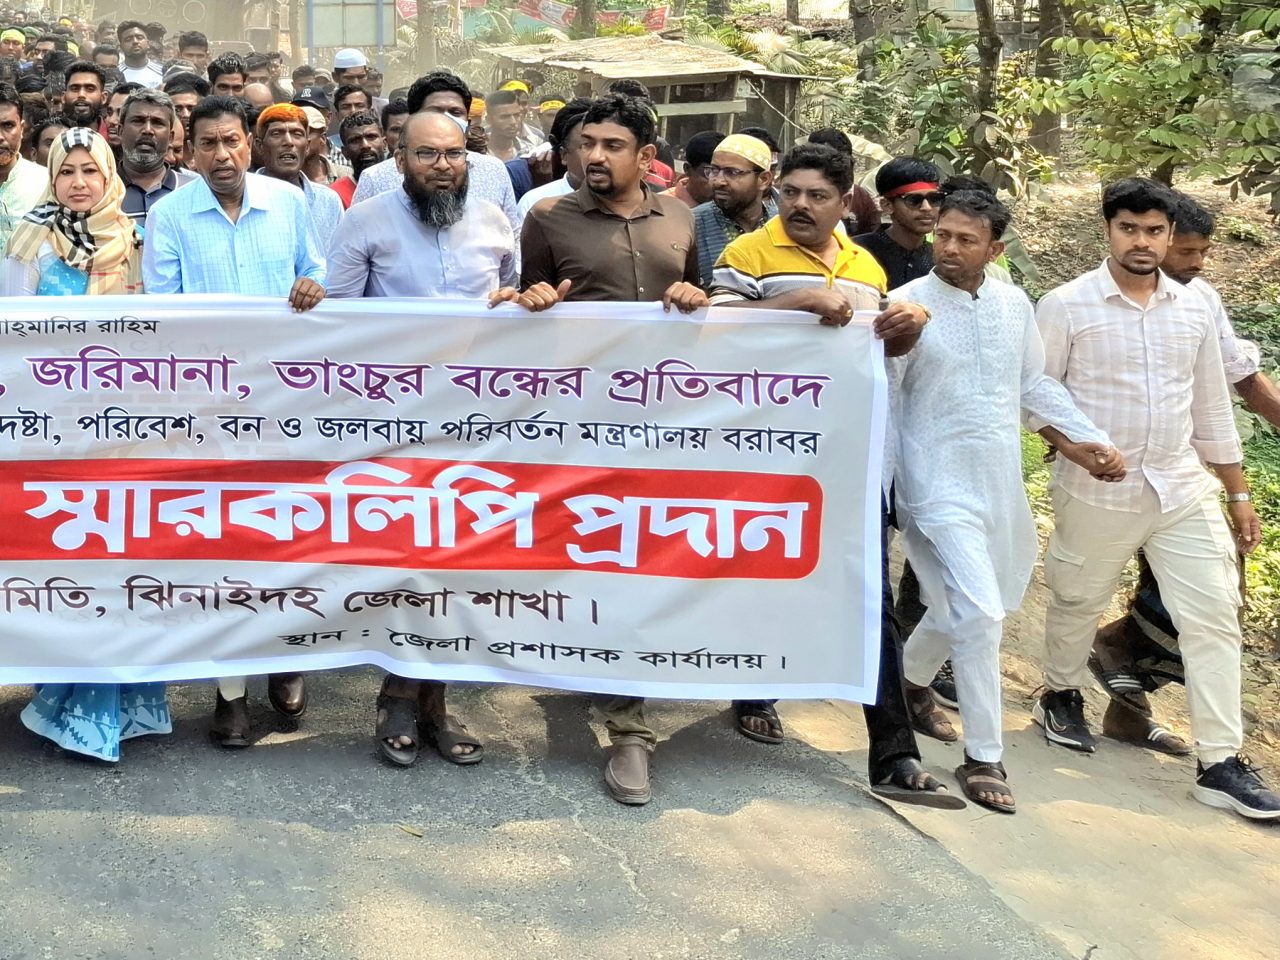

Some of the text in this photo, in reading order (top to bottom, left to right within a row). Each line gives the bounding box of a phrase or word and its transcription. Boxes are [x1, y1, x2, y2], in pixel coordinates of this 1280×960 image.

[96, 316, 160, 335] রাহিম
[25, 344, 252, 399] জরিমানা,
[271, 356, 433, 404] ভাংচুর
[445, 363, 591, 401] বন্ধের
[607, 358, 833, 409] প্রতিবাদে
[76, 406, 206, 445] পরিবেশ,
[218, 414, 263, 441] বন
[277, 418, 303, 439] ও
[439, 410, 570, 445] পরিবর্তন
[577, 420, 713, 452] মন্ত্রণালয়
[720, 426, 823, 456] বরাবর
[23, 460, 540, 554] স্মারকলিপি
[563, 492, 810, 568] প্রদান
[120, 574, 326, 620] ঝিনাইদহ
[343, 586, 457, 618] জেলা
[465, 588, 572, 623] শাখা
[384, 626, 478, 653] জেলা
[486, 640, 625, 665] প্রশাসক
[633, 647, 768, 670] কার্যালয়
